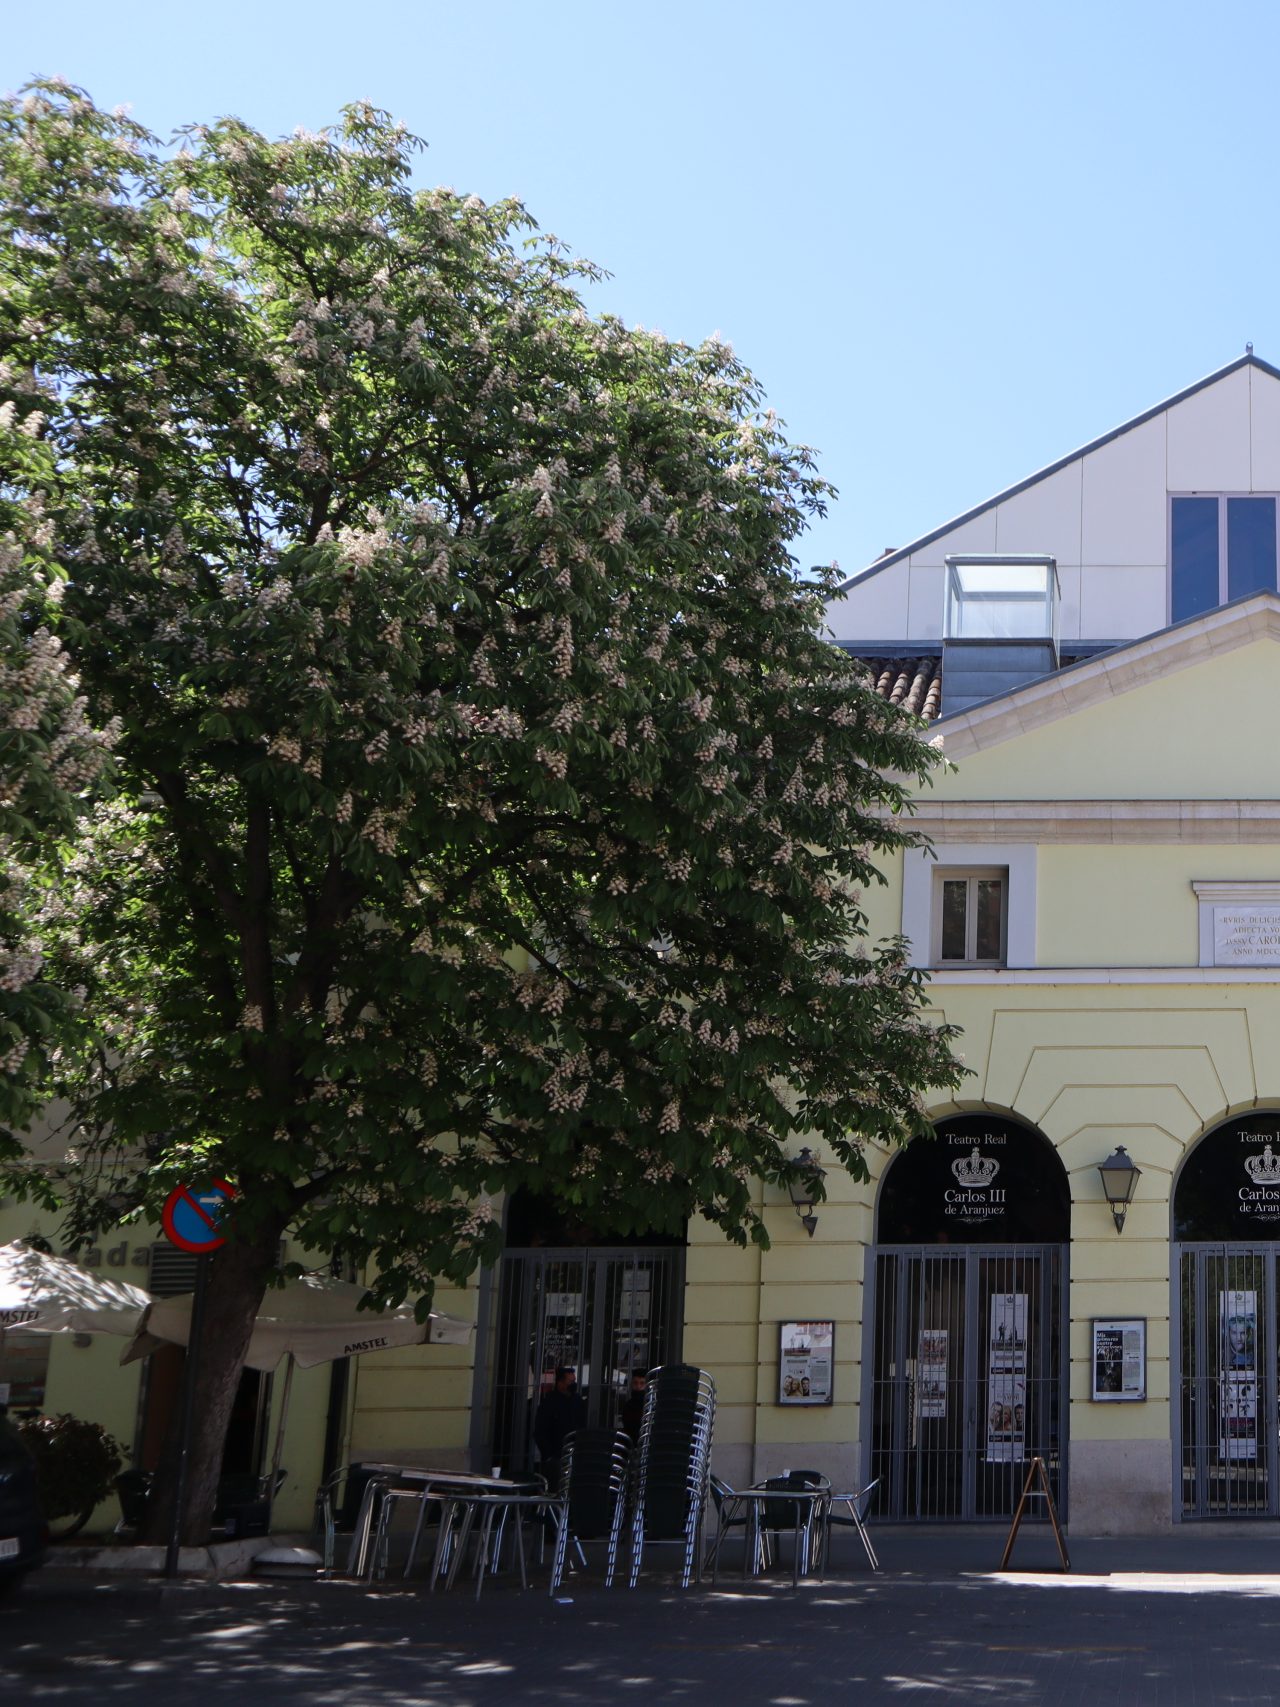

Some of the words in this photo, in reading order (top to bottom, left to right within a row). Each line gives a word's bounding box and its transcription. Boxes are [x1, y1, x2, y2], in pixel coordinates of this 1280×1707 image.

[946, 1134, 980, 1144] Teatro
[985, 1133, 1006, 1144] Real
[1238, 1132, 1272, 1142] Teatro
[944, 1190, 985, 1202] Carlos
[990, 1190, 1006, 1202] III
[1239, 1187, 1279, 1200] Carlos
[945, 1204, 956, 1214] de
[960, 1204, 1004, 1217] Aranjuez
[1240, 1202, 1251, 1212] de
[344, 1336, 388, 1354] AMSTEL
